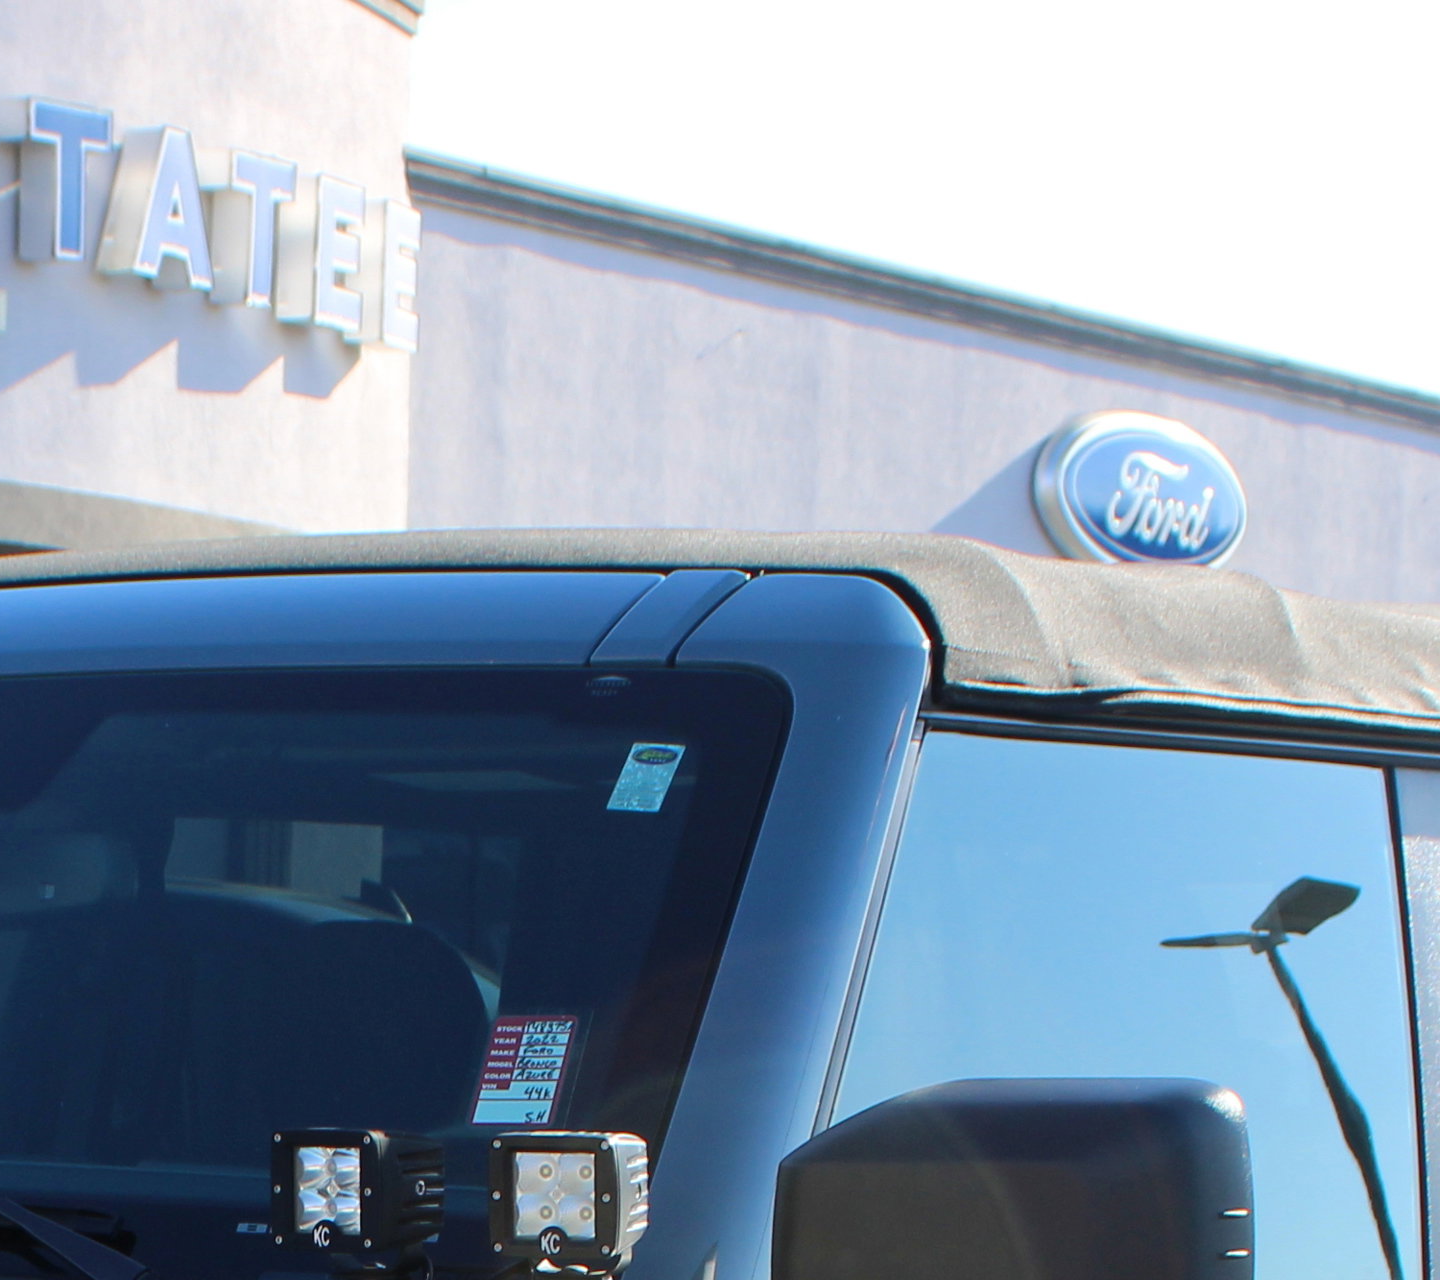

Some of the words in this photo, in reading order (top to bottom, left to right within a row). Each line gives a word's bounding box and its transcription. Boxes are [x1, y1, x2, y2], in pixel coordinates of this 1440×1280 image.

[1106, 451, 1214, 552] Ford
[313, 1228, 330, 1248] KC
[540, 1232, 561, 1255] KC
